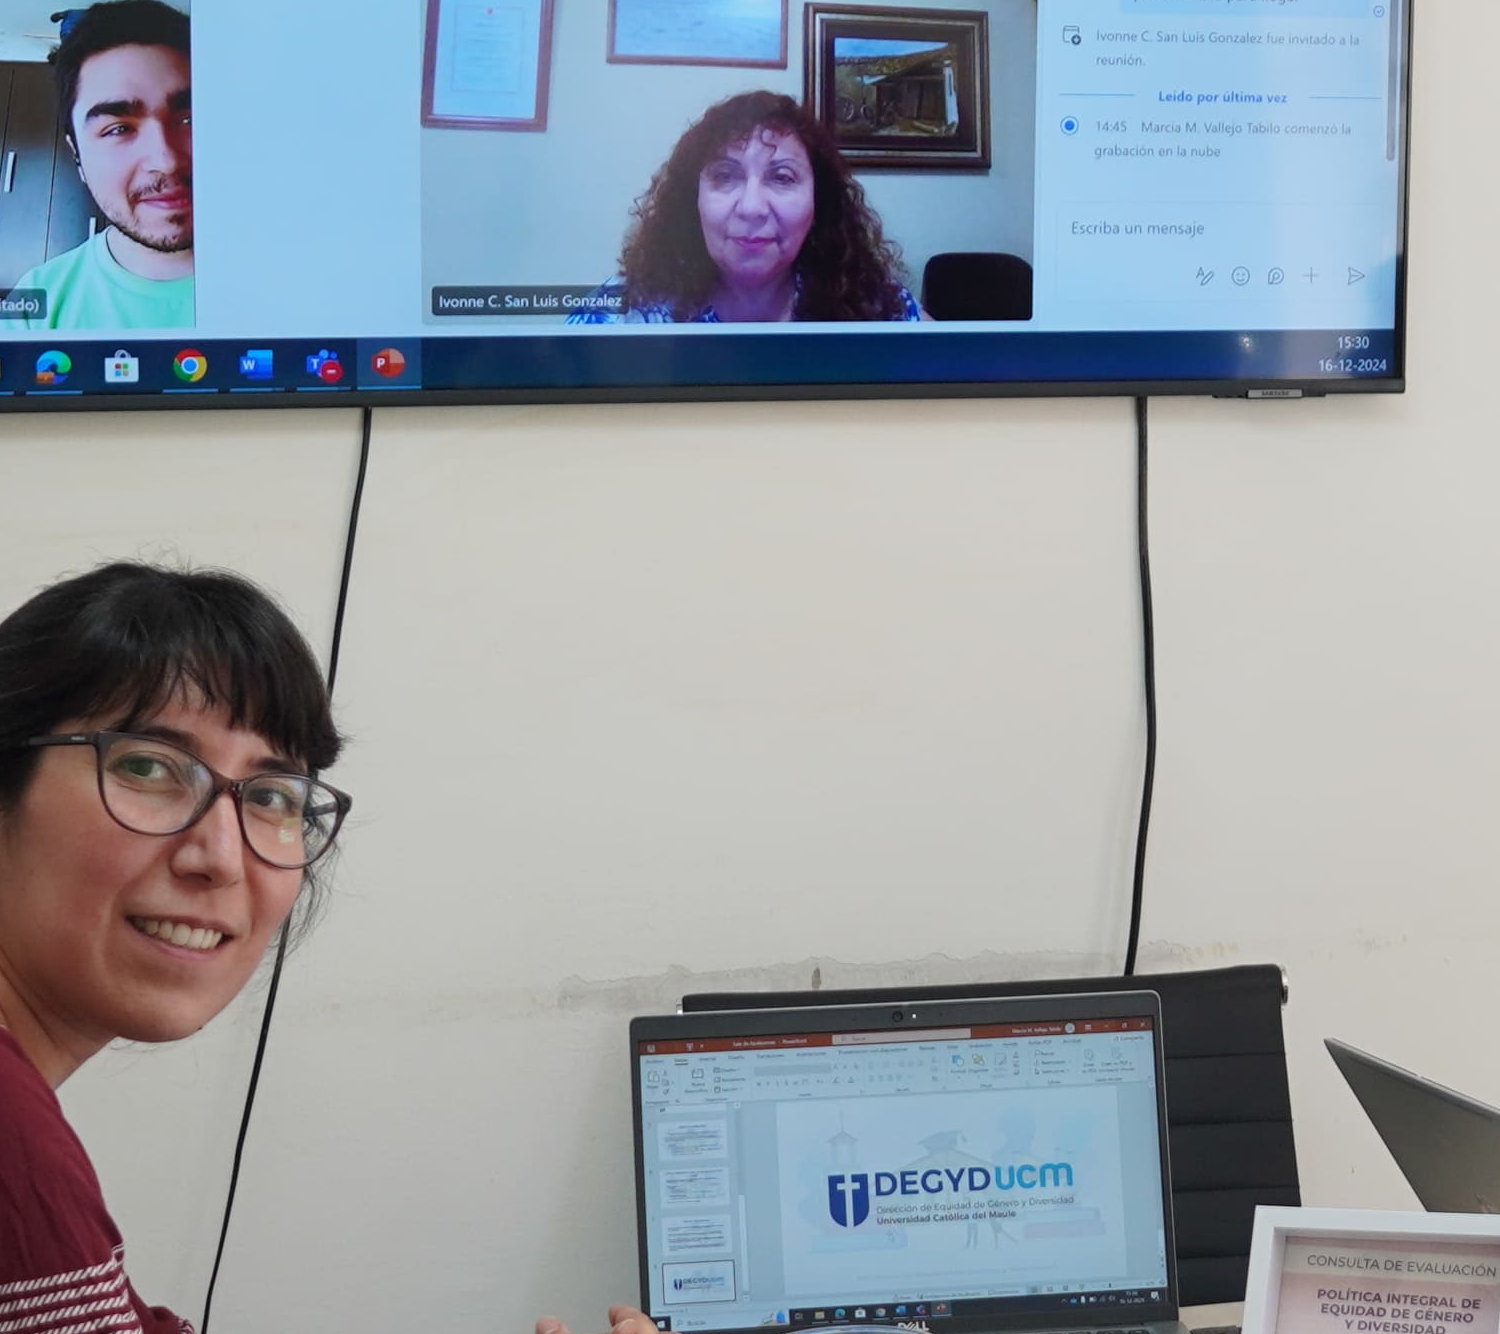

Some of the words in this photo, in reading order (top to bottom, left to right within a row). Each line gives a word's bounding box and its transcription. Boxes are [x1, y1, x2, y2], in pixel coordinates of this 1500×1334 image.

[1158, 91, 1193, 102] Leído
[1197, 93, 1219, 105] por
[1223, 91, 1262, 103] última
[1267, 94, 1287, 103] vez
[1096, 122, 1127, 133] 14:45
[1141, 122, 1181, 134] Marcia
[1185, 123, 1200, 133] M.
[1204, 123, 1242, 136] Vallejo
[1247, 124, 1280, 134] Tabilo
[1284, 124, 1338, 135] comenzó
[1342, 124, 1350, 135] la
[1094, 146, 1154, 160] grabación
[1158, 149, 1173, 157] en
[1177, 147, 1187, 157] la
[1191, 147, 1220, 158] nube
[1071, 222, 1120, 235] Escriba
[1126, 225, 1142, 235] un
[1147, 223, 1204, 237] mensaje
[439, 295, 484, 307] Ivonne
[488, 296, 501, 307] C.
[505, 295, 528, 307] San
[533, 295, 558, 307] Luis
[562, 294, 622, 307] Gonzalez
[1338, 336, 1370, 349] 15:30
[1319, 359, 1387, 372] 16-12-2024
[877, 1205, 918, 1215] Dirección
[920, 1203, 932, 1212] de
[935, 1202, 971, 1212] Equidad
[974, 1200, 985, 1209] de
[988, 1199, 1019, 1208] Género
[1021, 1200, 1026, 1208] y
[1029, 1196, 1074, 1206] Diversidad
[877, 1215, 930, 1225] Universidad
[933, 1212, 969, 1222] Católica
[972, 1211, 986, 1220] del
[989, 1210, 1016, 1218] Maule
[1307, 1254, 1380, 1270] CONSULTA
[1384, 1260, 1403, 1271] DE
[1407, 1261, 1497, 1277] EVALUACIÓN
[1317, 1288, 1381, 1303] POLÍTICA
[1387, 1294, 1456, 1308] INTEGRAL
[1461, 1299, 1481, 1309] DE
[1321, 1303, 1386, 1317] EQUIDAD
[1391, 1308, 1409, 1319] DE
[1414, 1308, 1473, 1323] GÉNERO
[898, 1321, 929, 1331] DELL
[1345, 1320, 1353, 1329] Y
